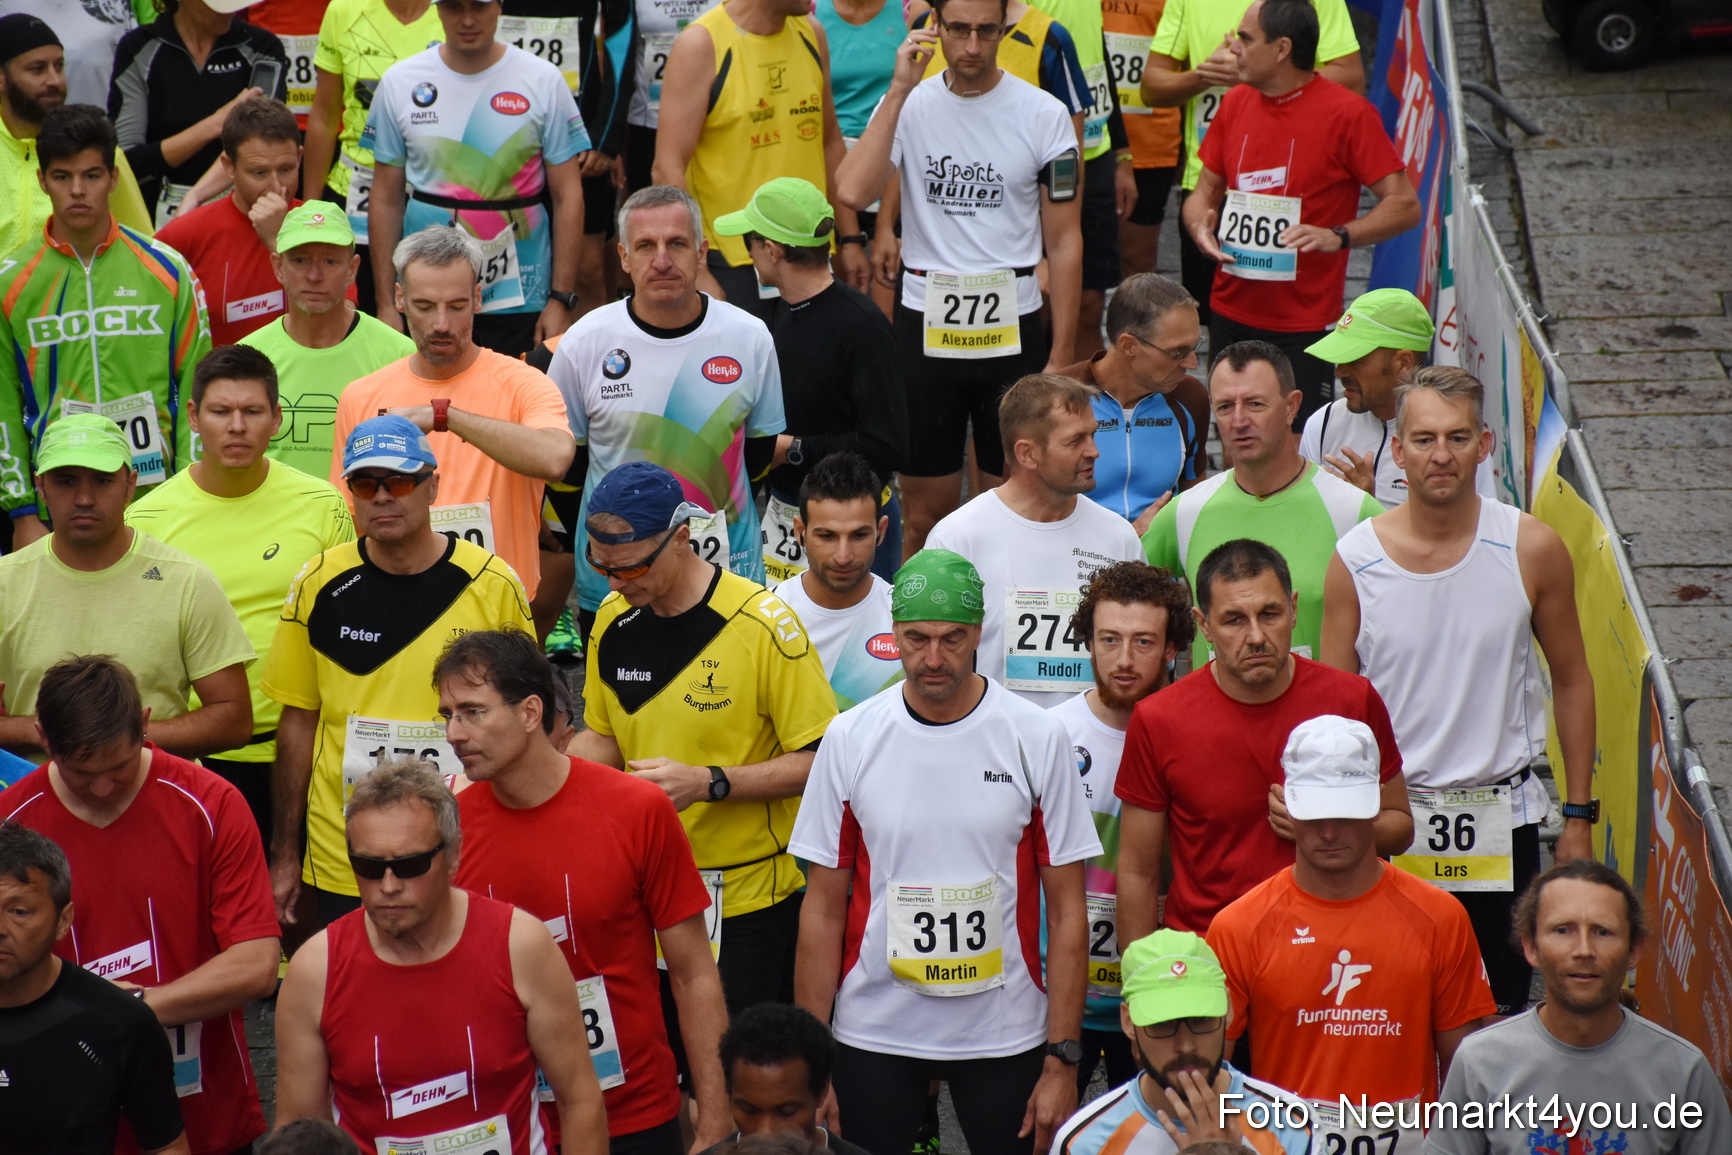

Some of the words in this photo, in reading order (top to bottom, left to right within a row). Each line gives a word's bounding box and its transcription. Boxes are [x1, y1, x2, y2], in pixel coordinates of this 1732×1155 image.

[207, 60, 242, 72] FALKE
[495, 97, 527, 110] Hervis
[411, 111, 439, 120] PARTL
[1250, 175, 1273, 186] DEHN
[928, 182, 1001, 200] Müller
[940, 199, 973, 208] Andreas
[974, 201, 1002, 209] Winter
[1250, 197, 1292, 211] BOCK
[944, 208, 976, 217] Neumarkt
[1225, 211, 1290, 249] 2668
[1232, 251, 1273, 269] Edmund
[964, 272, 1009, 287] BOCK
[242, 299, 269, 314] DEHN
[943, 292, 1000, 325] 272
[27, 304, 165, 348] BOCK
[941, 332, 1003, 347] Alexander
[707, 362, 738, 377] Hervis
[601, 382, 633, 395] PARTL
[601, 391, 633, 401] Neumarkt
[100, 396, 146, 416] BOCK
[354, 437, 372, 448] BASE
[331, 574, 361, 598] STANNO
[1015, 599, 1050, 607] NeuerMarkt
[617, 608, 641, 628] STANNO
[339, 626, 382, 643] Peter
[1017, 612, 1092, 652] 274
[700, 659, 720, 669] TSV
[1037, 661, 1083, 678] Rudolf
[616, 667, 652, 683] Markus
[683, 693, 732, 713] Burgthann
[354, 729, 391, 738] NeuerMarkt
[983, 770, 1013, 783] Martin
[1443, 790, 1500, 805] BOCK
[1427, 812, 1476, 852] 36
[1434, 861, 1468, 878] Lars
[896, 895, 935, 904] NeuerMarkt
[941, 882, 994, 902] BOCK
[913, 909, 987, 954] 313
[1291, 936, 1316, 945] erima
[1661, 897, 1697, 994] CLINIC
[892, 949, 898, 958] B
[99, 955, 131, 977] DEHN
[925, 963, 978, 981] Martin
[1296, 1008, 1388, 1027] funrunners
[1323, 1020, 1403, 1037] neumarkt
[412, 1084, 447, 1106] DEHN
